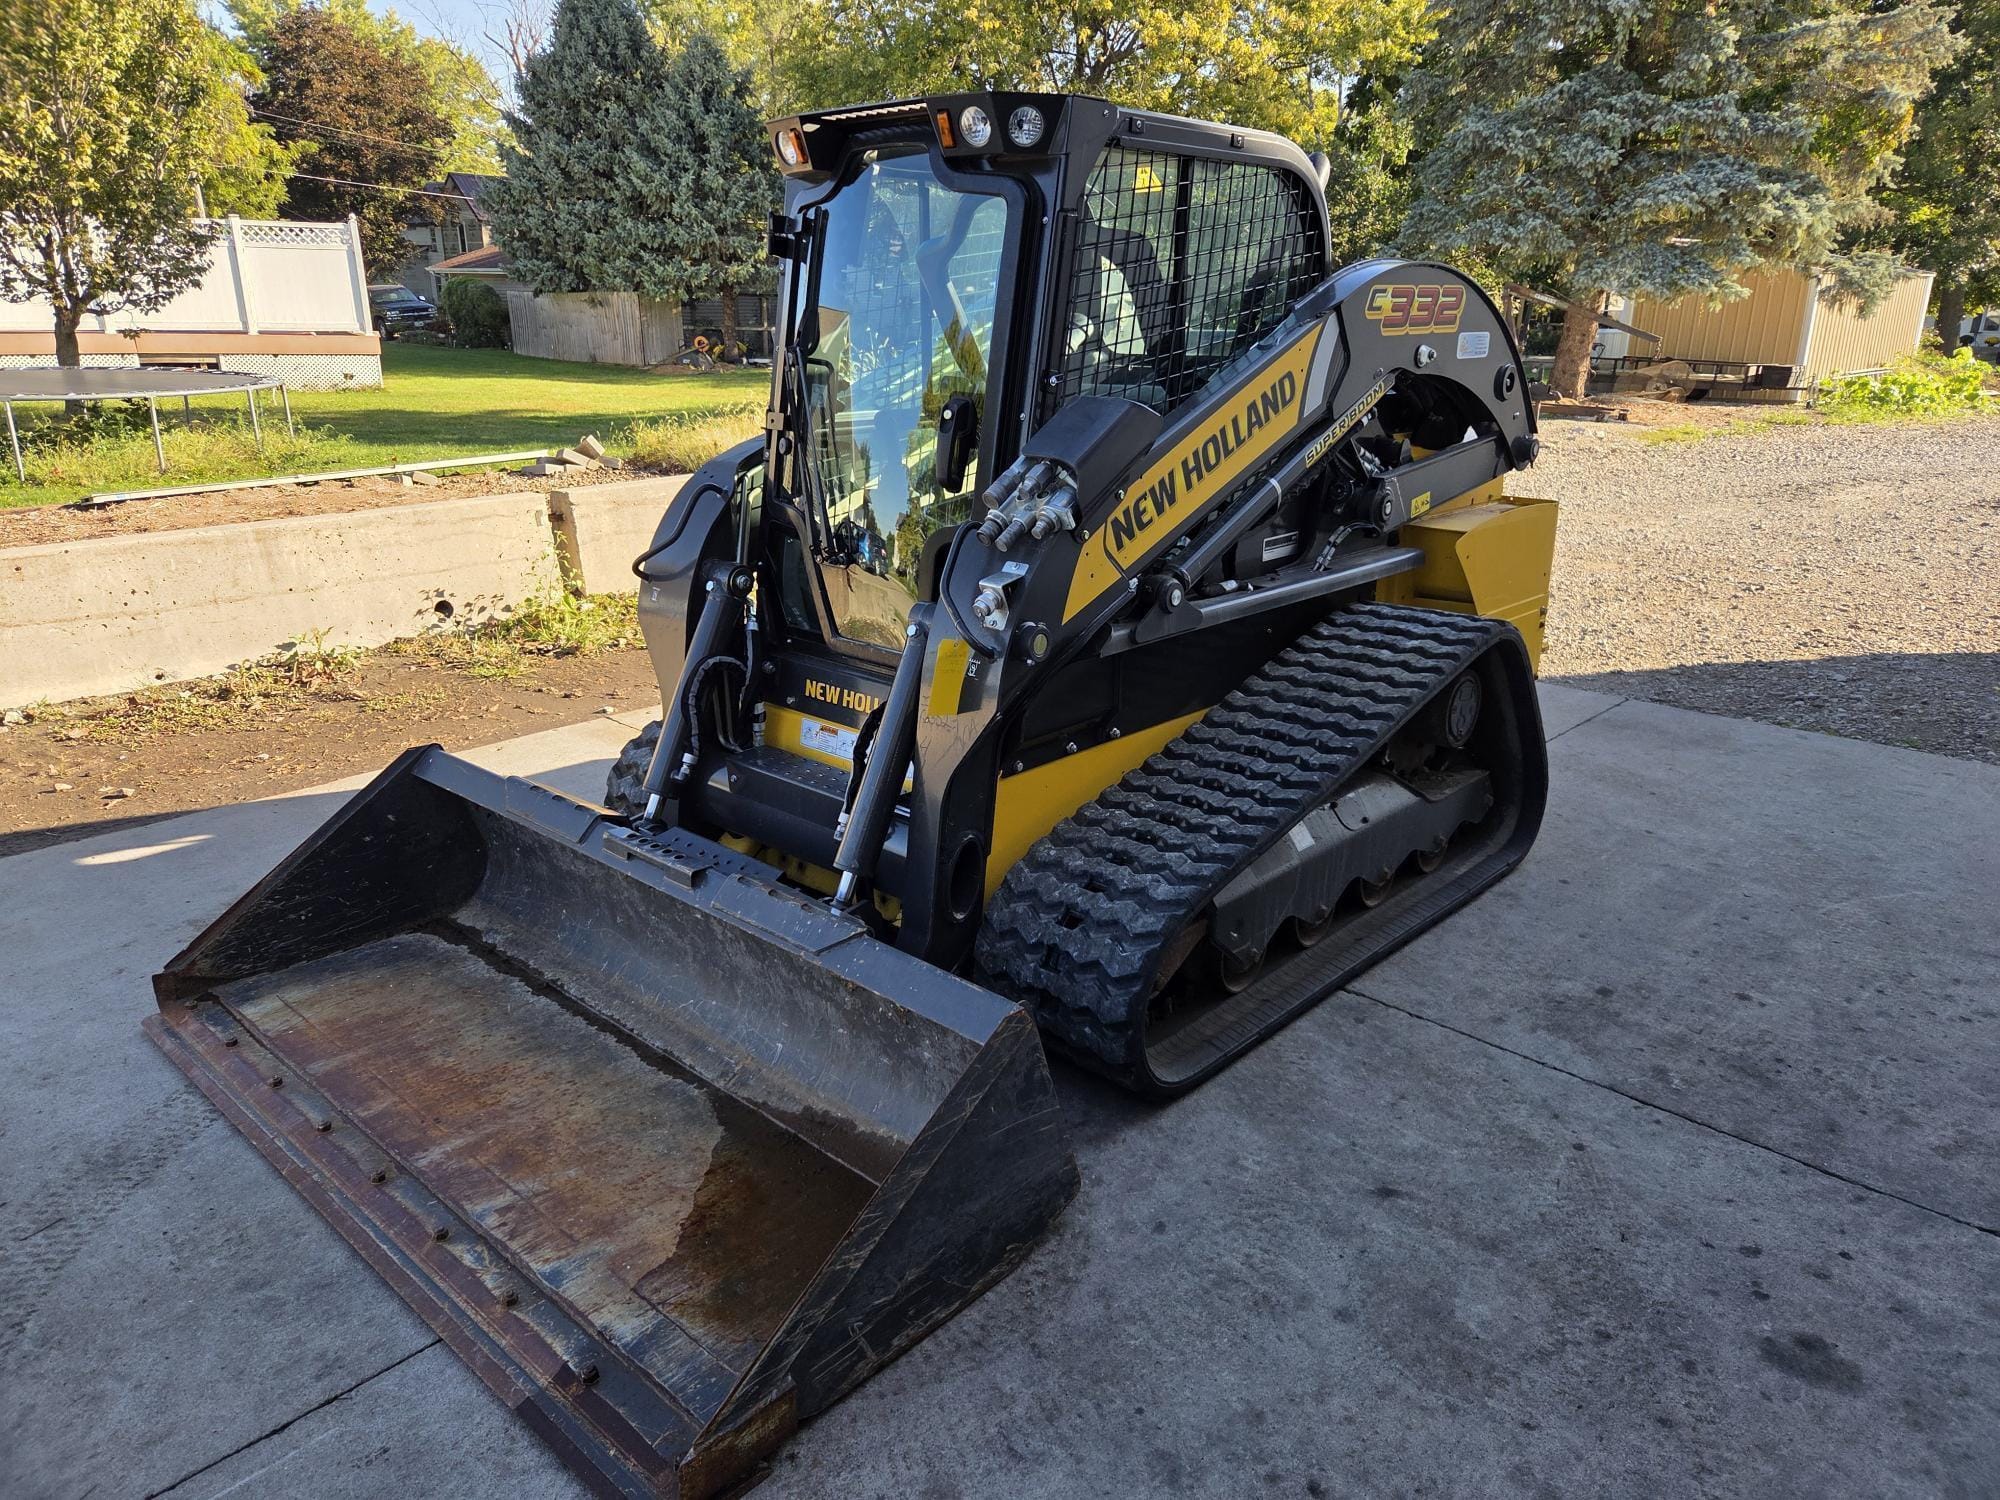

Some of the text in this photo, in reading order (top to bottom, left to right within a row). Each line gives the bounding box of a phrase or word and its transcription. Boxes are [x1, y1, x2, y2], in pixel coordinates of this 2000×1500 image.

[1365, 285, 1466, 336] C332
[1306, 382, 1384, 465] SUPER BOOM
[1111, 371, 1296, 552] NEW HOLLAND
[805, 678, 840, 705] NEW
